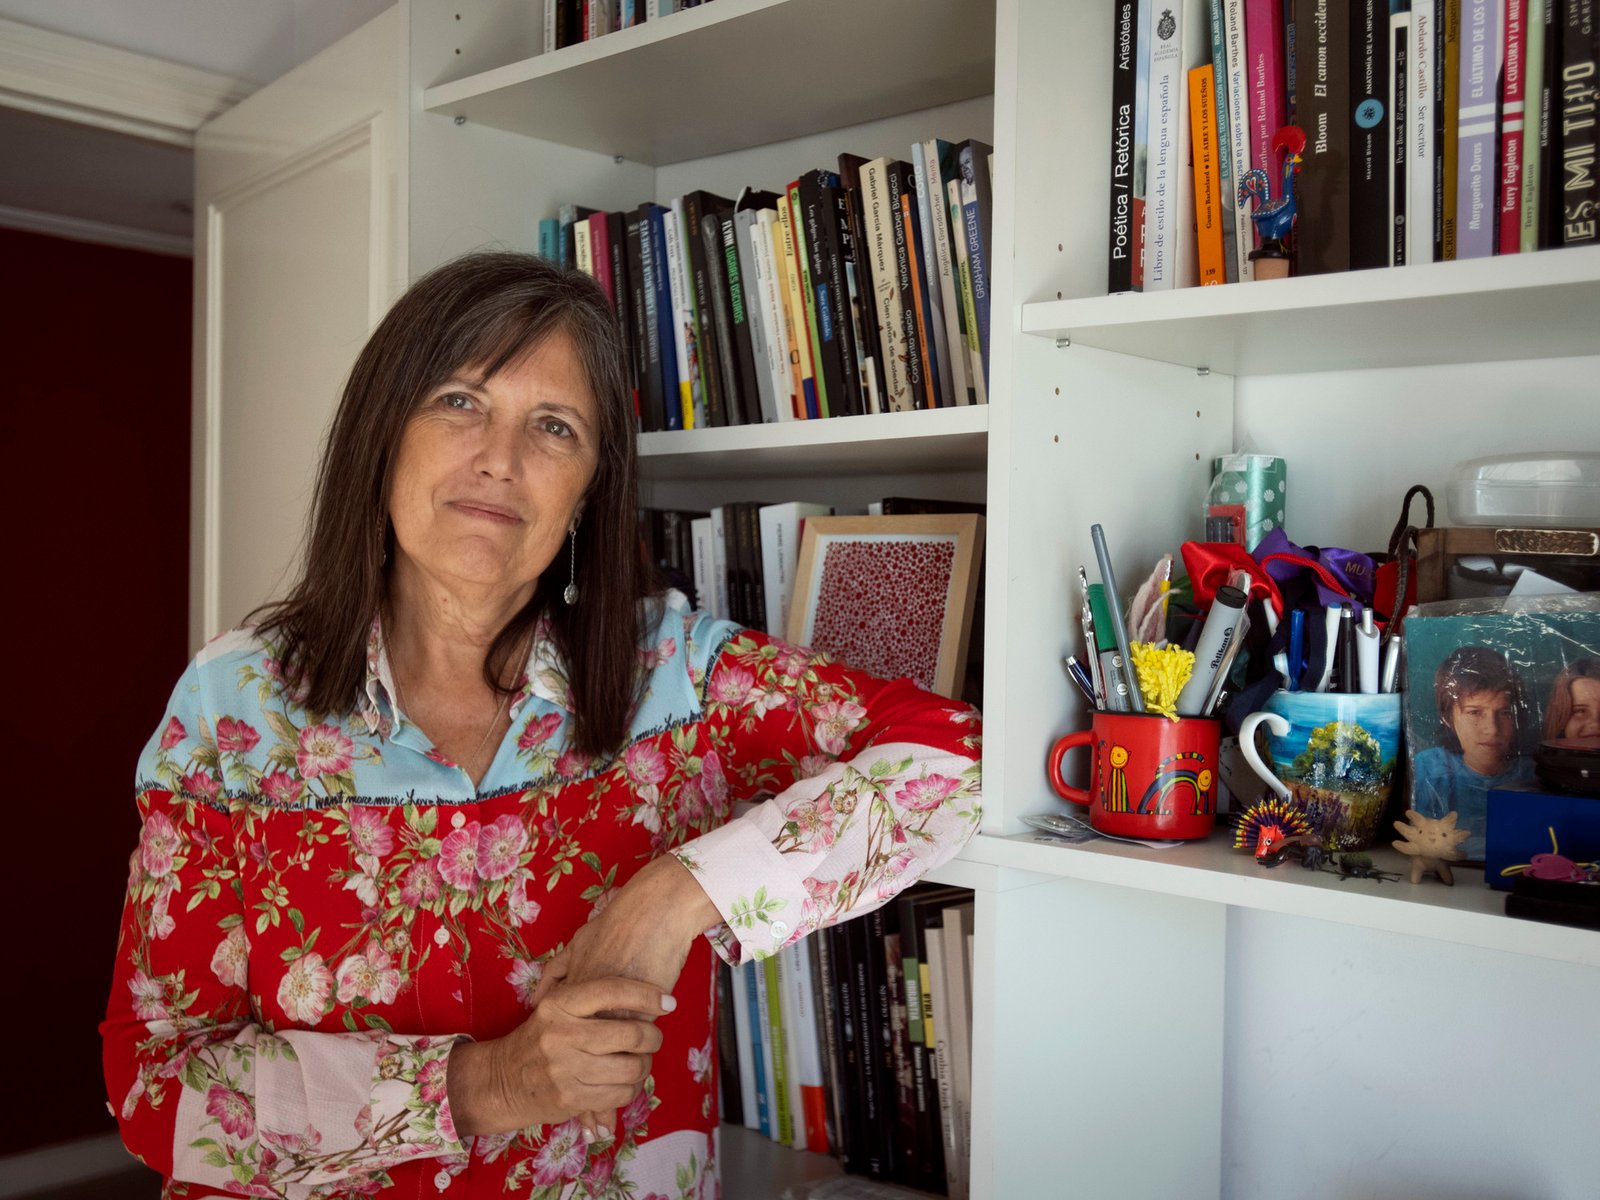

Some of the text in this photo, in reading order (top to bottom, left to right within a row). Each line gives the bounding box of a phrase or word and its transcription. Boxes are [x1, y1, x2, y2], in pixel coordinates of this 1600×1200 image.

[1229, 2, 1237, 31] Roland
[1473, 6, 1485, 26] LOS
[1508, 21, 1519, 32] LA
[1118, 3, 1132, 70] Aristóteles
[1230, 34, 1238, 68] Barthes
[1366, 32, 1373, 42] LA
[1366, 45, 1373, 55] DE
[1473, 28, 1485, 42] DE
[1507, 34, 1518, 42] Y
[1255, 54, 1264, 86] Barthes
[1317, 46, 1327, 82] canon
[1364, 56, 1372, 94] ANATOMÍA
[1470, 46, 1484, 84] ÚLTIMO
[1506, 43, 1518, 82] CULTURA
[1200, 78, 1208, 108] SUEÑOS
[1216, 84, 1225, 110] LECCIÓN
[1232, 70, 1240, 120] Variaciones
[1314, 84, 1327, 97] El
[1417, 15, 1426, 158] Abelardo Castillo Ser escritor
[1472, 86, 1484, 98] EL
[1506, 84, 1517, 94] LA
[1256, 90, 1266, 122] Roland
[1218, 115, 1226, 134] TEXTO
[1220, 135, 1228, 145] DEL
[1234, 122, 1242, 146] sobre
[1258, 124, 1268, 138] por
[1315, 112, 1328, 153] Bloom
[1115, 104, 1131, 178] Retórica
[1202, 132, 1210, 151] AIRE
[1203, 152, 1210, 162] EL
[1236, 148, 1242, 156] la
[1562, 61, 1600, 242] ES MI TIPO
[1220, 146, 1228, 169] PLACER
[914, 164, 925, 198] CORO
[1153, 74, 1170, 282] Libro de estilo de la lengua española
[1204, 170, 1212, 204] Bachelard
[1222, 170, 1228, 178] EL
[1469, 142, 1484, 230] Marguerite Duras
[1503, 139, 1518, 212] Terry Eagleton
[1524, 164, 1535, 230] Terry Eagleton
[722, 220, 733, 246] FLYNN
[782, 206, 791, 228] ellos
[929, 159, 950, 276] Angélica Gorodischer Menta
[966, 207, 980, 251] GREENE
[1113, 194, 1128, 260] Poética
[784, 230, 792, 256] Entre
[1445, 218, 1455, 259] SCRIBIR
[725, 246, 740, 284] LUGARES
[889, 173, 920, 384] Conjunto vacío Verónica Gerber Bicecci
[972, 254, 985, 299] GRAHAM
[868, 168, 900, 396] Gabriel García Márquez Cien años de soledad
[730, 286, 744, 325] OSCUROS
[1210, 637, 1230, 670] Pelikan
[315, 790, 345, 810] want
[406, 788, 436, 806] Love
